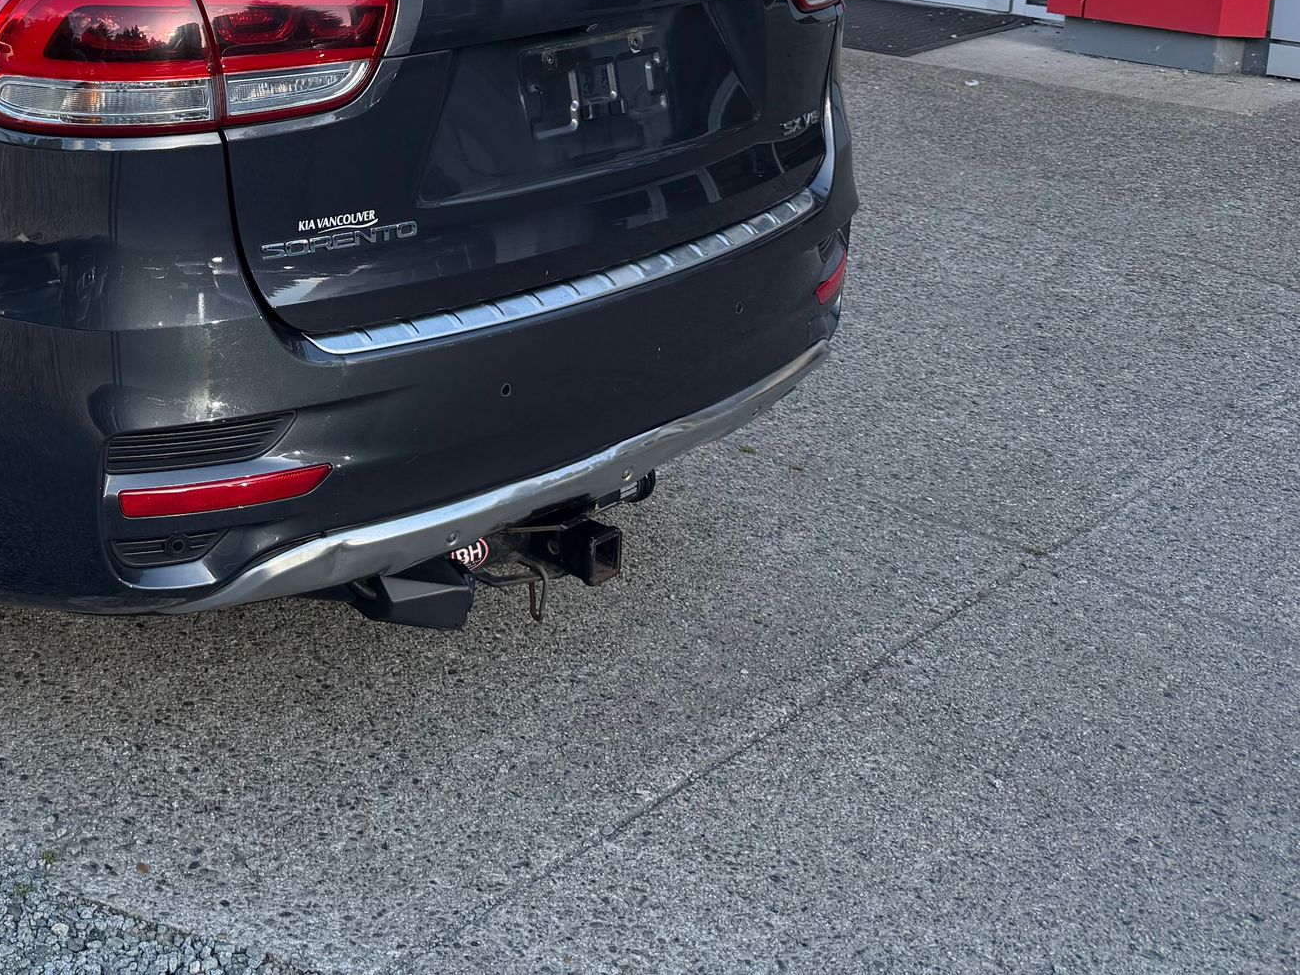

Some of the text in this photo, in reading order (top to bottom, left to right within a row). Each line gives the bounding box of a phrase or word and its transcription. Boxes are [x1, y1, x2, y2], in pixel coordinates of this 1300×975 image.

[298, 209, 376, 232] KIA VANCOUVER
[261, 220, 418, 261] SORENTO
